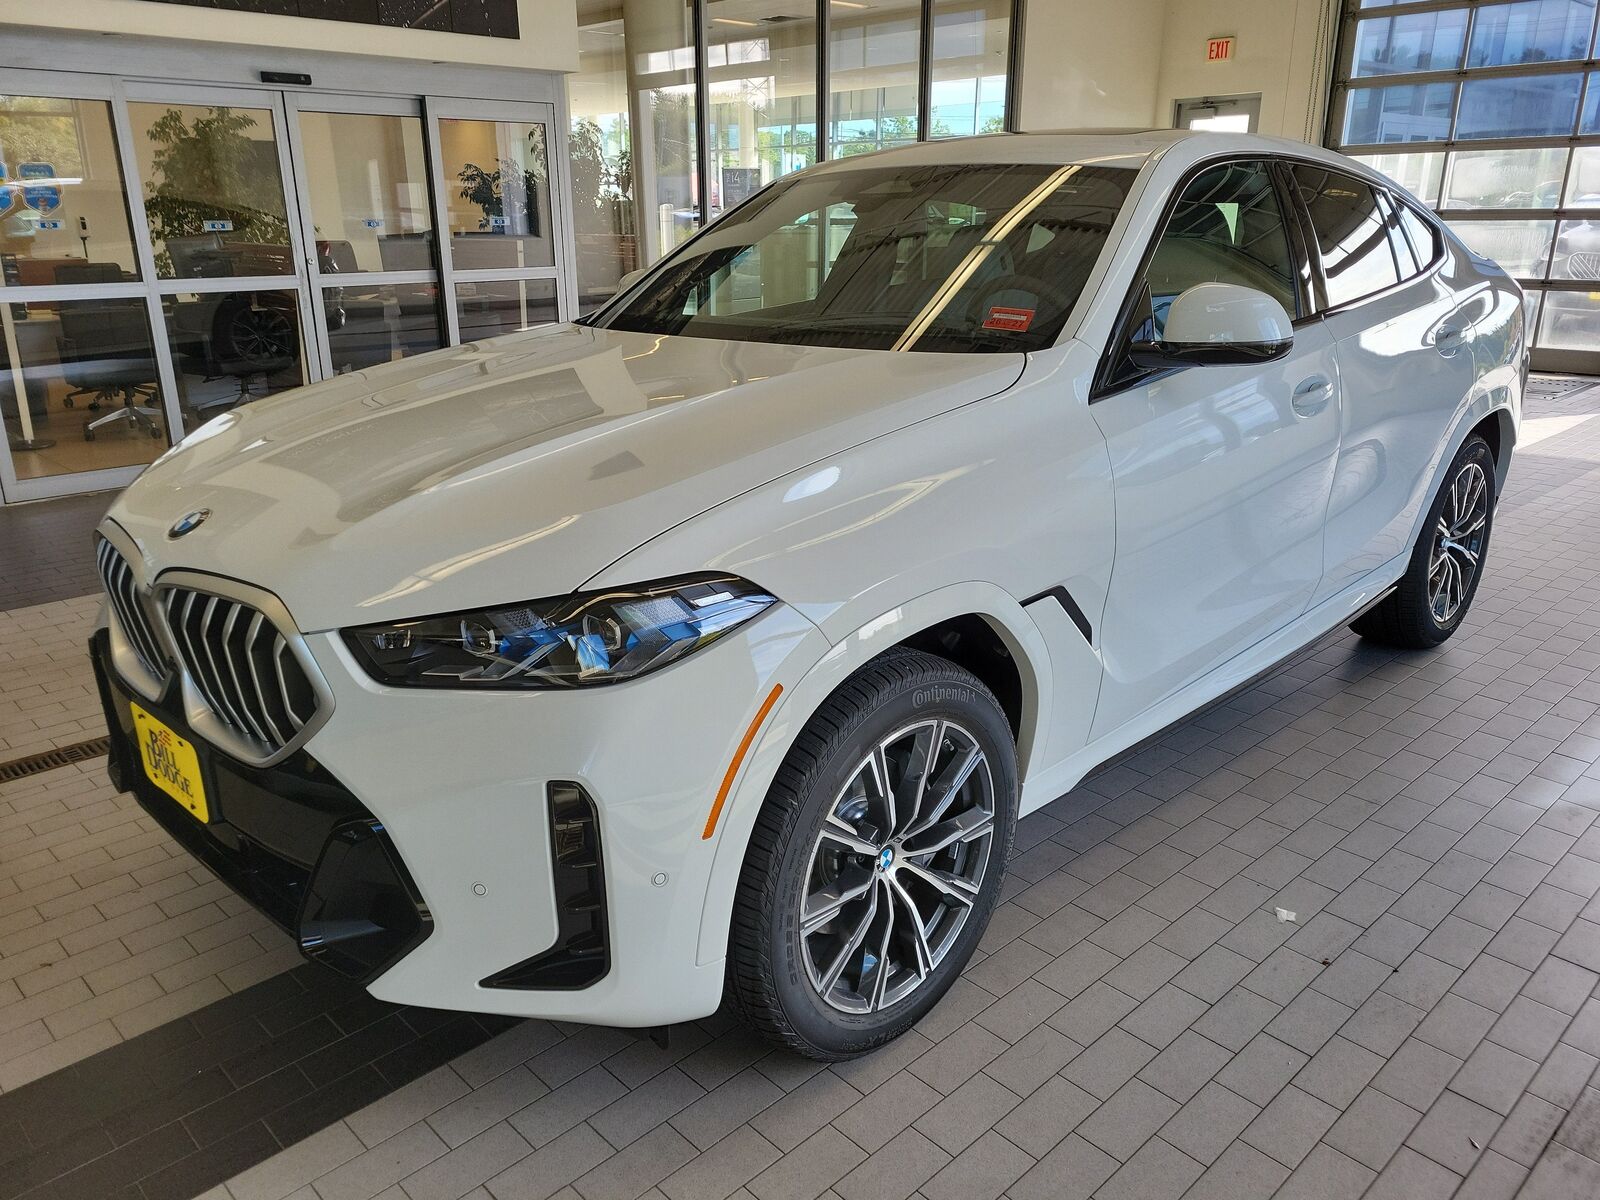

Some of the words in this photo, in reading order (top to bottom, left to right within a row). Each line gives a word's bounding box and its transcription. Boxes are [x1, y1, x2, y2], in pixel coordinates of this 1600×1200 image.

[1209, 41, 1230, 59] EXIT
[912, 685, 969, 708] Continental
[149, 729, 180, 772] BILL
[145, 741, 193, 798] DODGE
